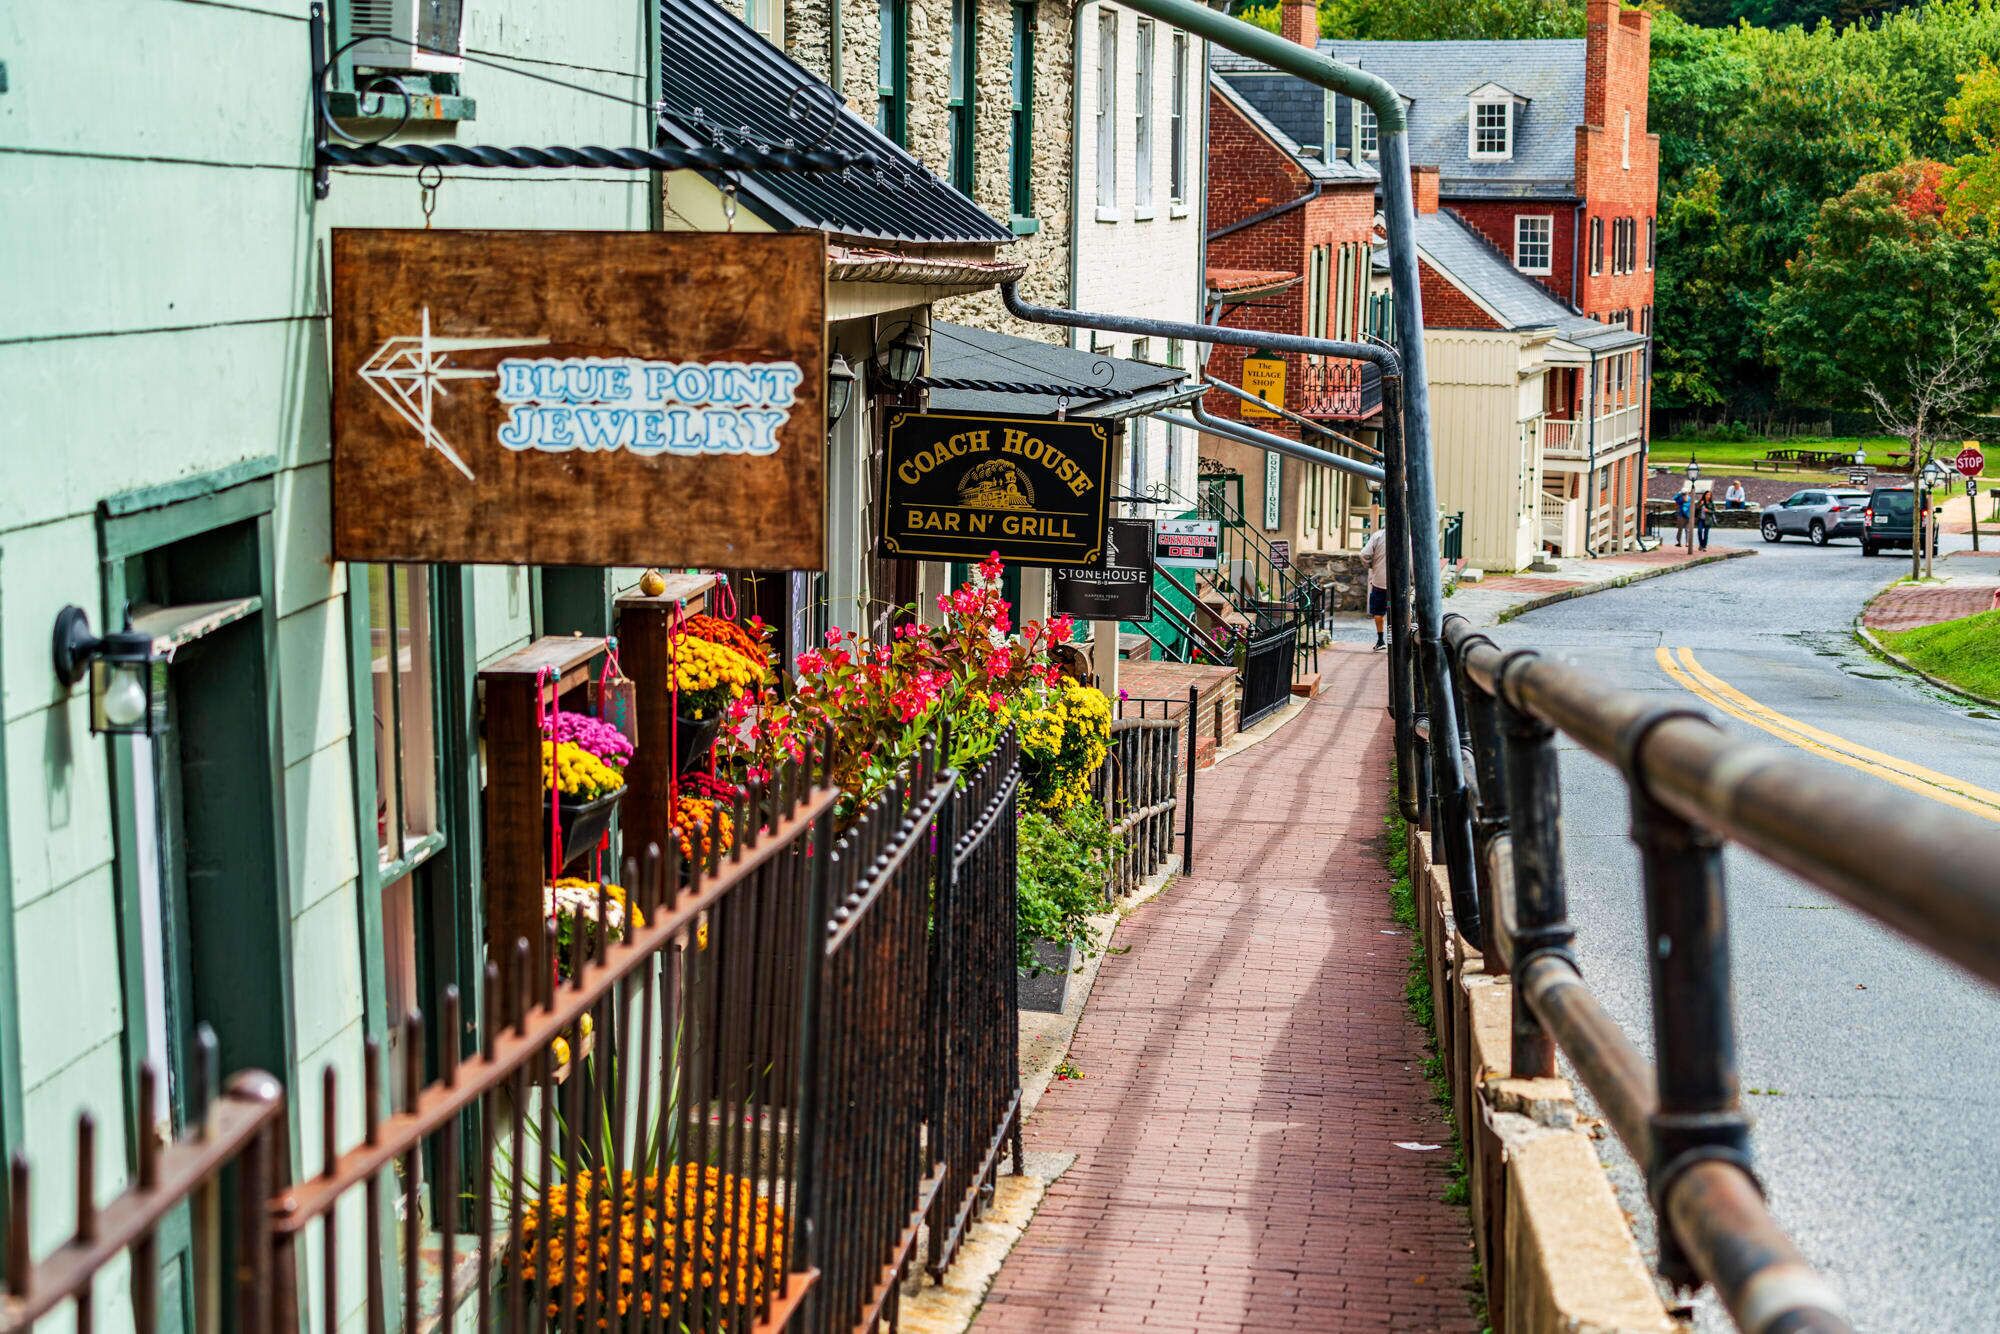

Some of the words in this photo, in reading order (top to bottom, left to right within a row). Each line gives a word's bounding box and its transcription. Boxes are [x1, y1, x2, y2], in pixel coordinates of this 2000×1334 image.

[1247, 371, 1281, 379] VILLAGE
[502, 363, 633, 400] BLUE
[643, 366, 799, 404] POINT
[1252, 379, 1275, 387] SHOP
[502, 407, 784, 450] JEWELRY
[898, 430, 990, 485] COACH
[1001, 428, 1095, 497] HOUSE
[1957, 456, 1983, 469] STOP
[1967, 481, 1975, 489] P
[907, 510, 961, 532] BAR
[969, 513, 994, 533] N'
[1002, 516, 1076, 538] GRILL
[1158, 533, 1217, 547] CANNONBALL
[1168, 546, 1204, 557] DELI
[1058, 568, 1147, 583] STONEHOUSE
